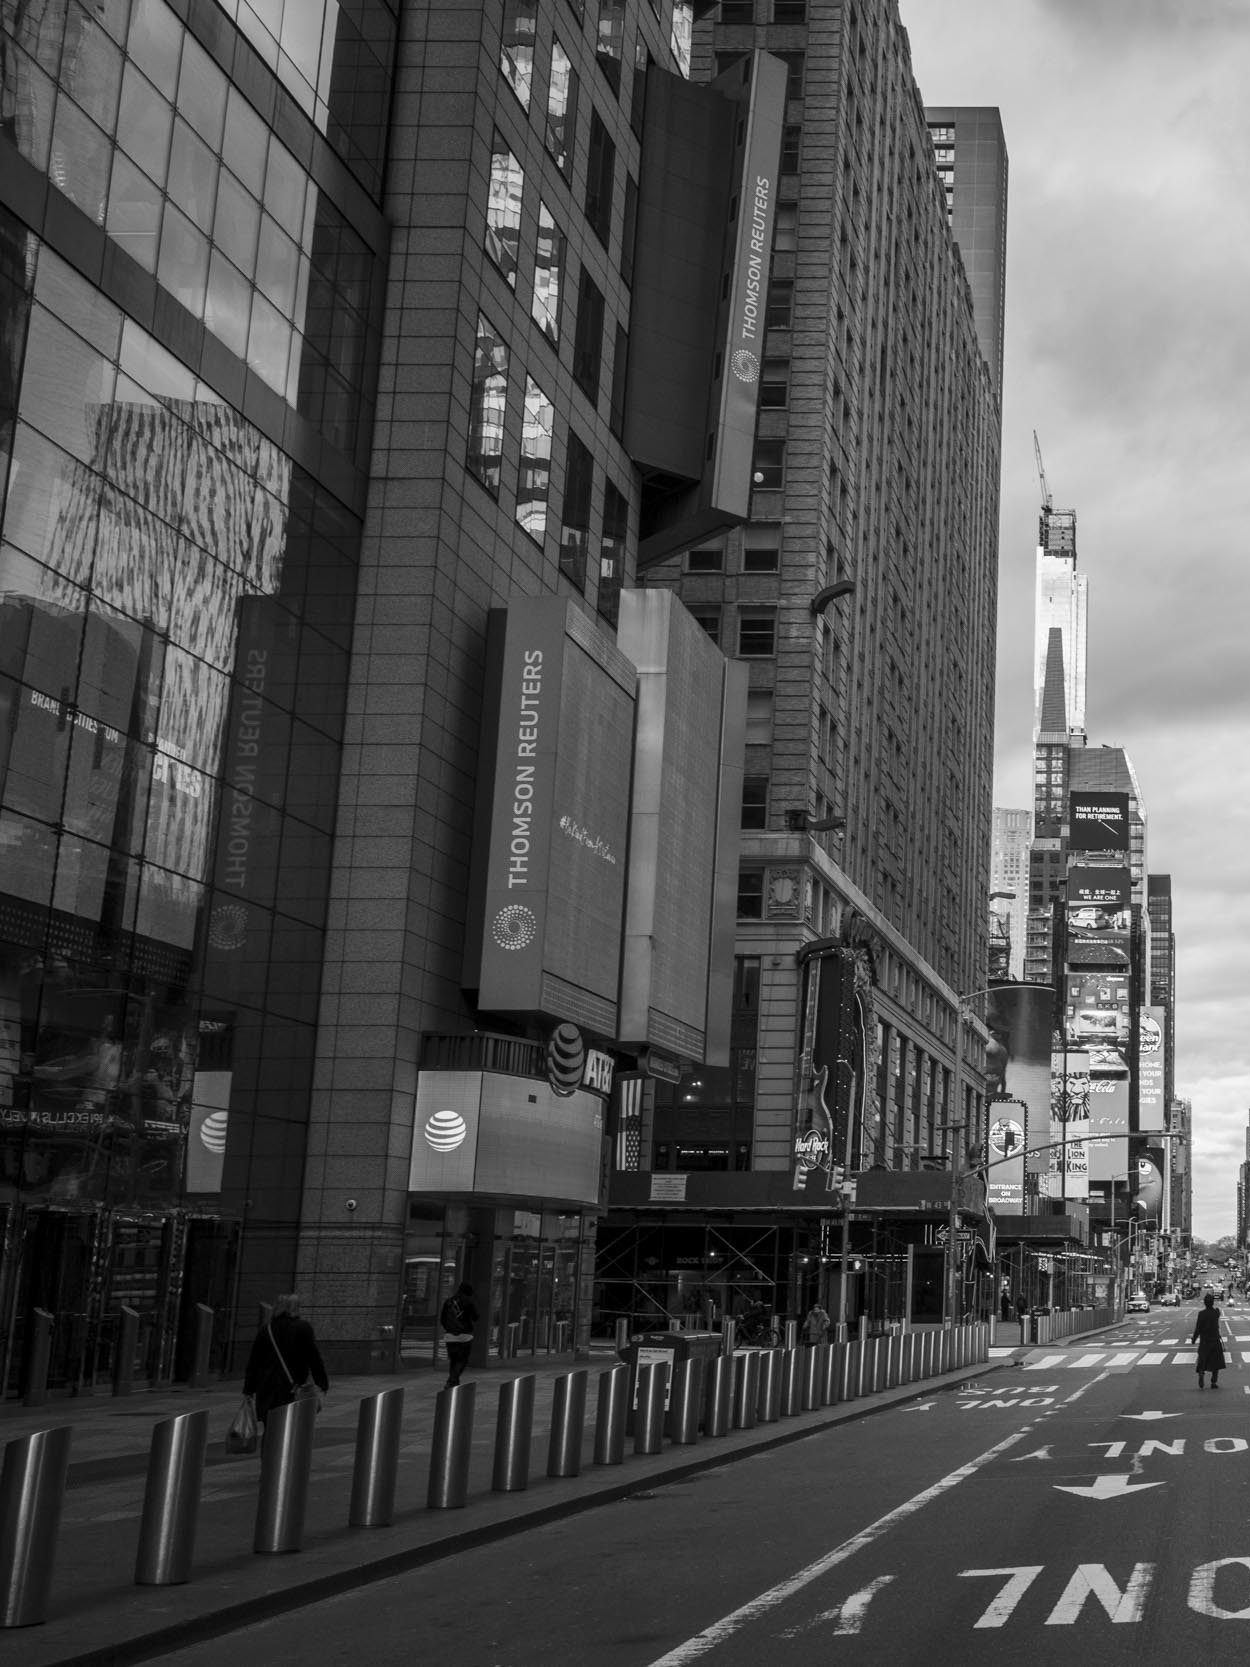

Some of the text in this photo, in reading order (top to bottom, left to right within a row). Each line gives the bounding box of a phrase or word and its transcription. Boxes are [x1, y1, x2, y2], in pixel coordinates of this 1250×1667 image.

[742, 176, 770, 339] THOMSON REUTERS
[507, 649, 544, 889] THOMSON REUTERS
[794, 1136, 829, 1154] Hard Rock
[1068, 1149, 1085, 1159] LION
[1071, 1141, 1083, 1149] THE
[1066, 1160, 1088, 1173] KING
[1009, 1436, 1250, 1462] ONLY
